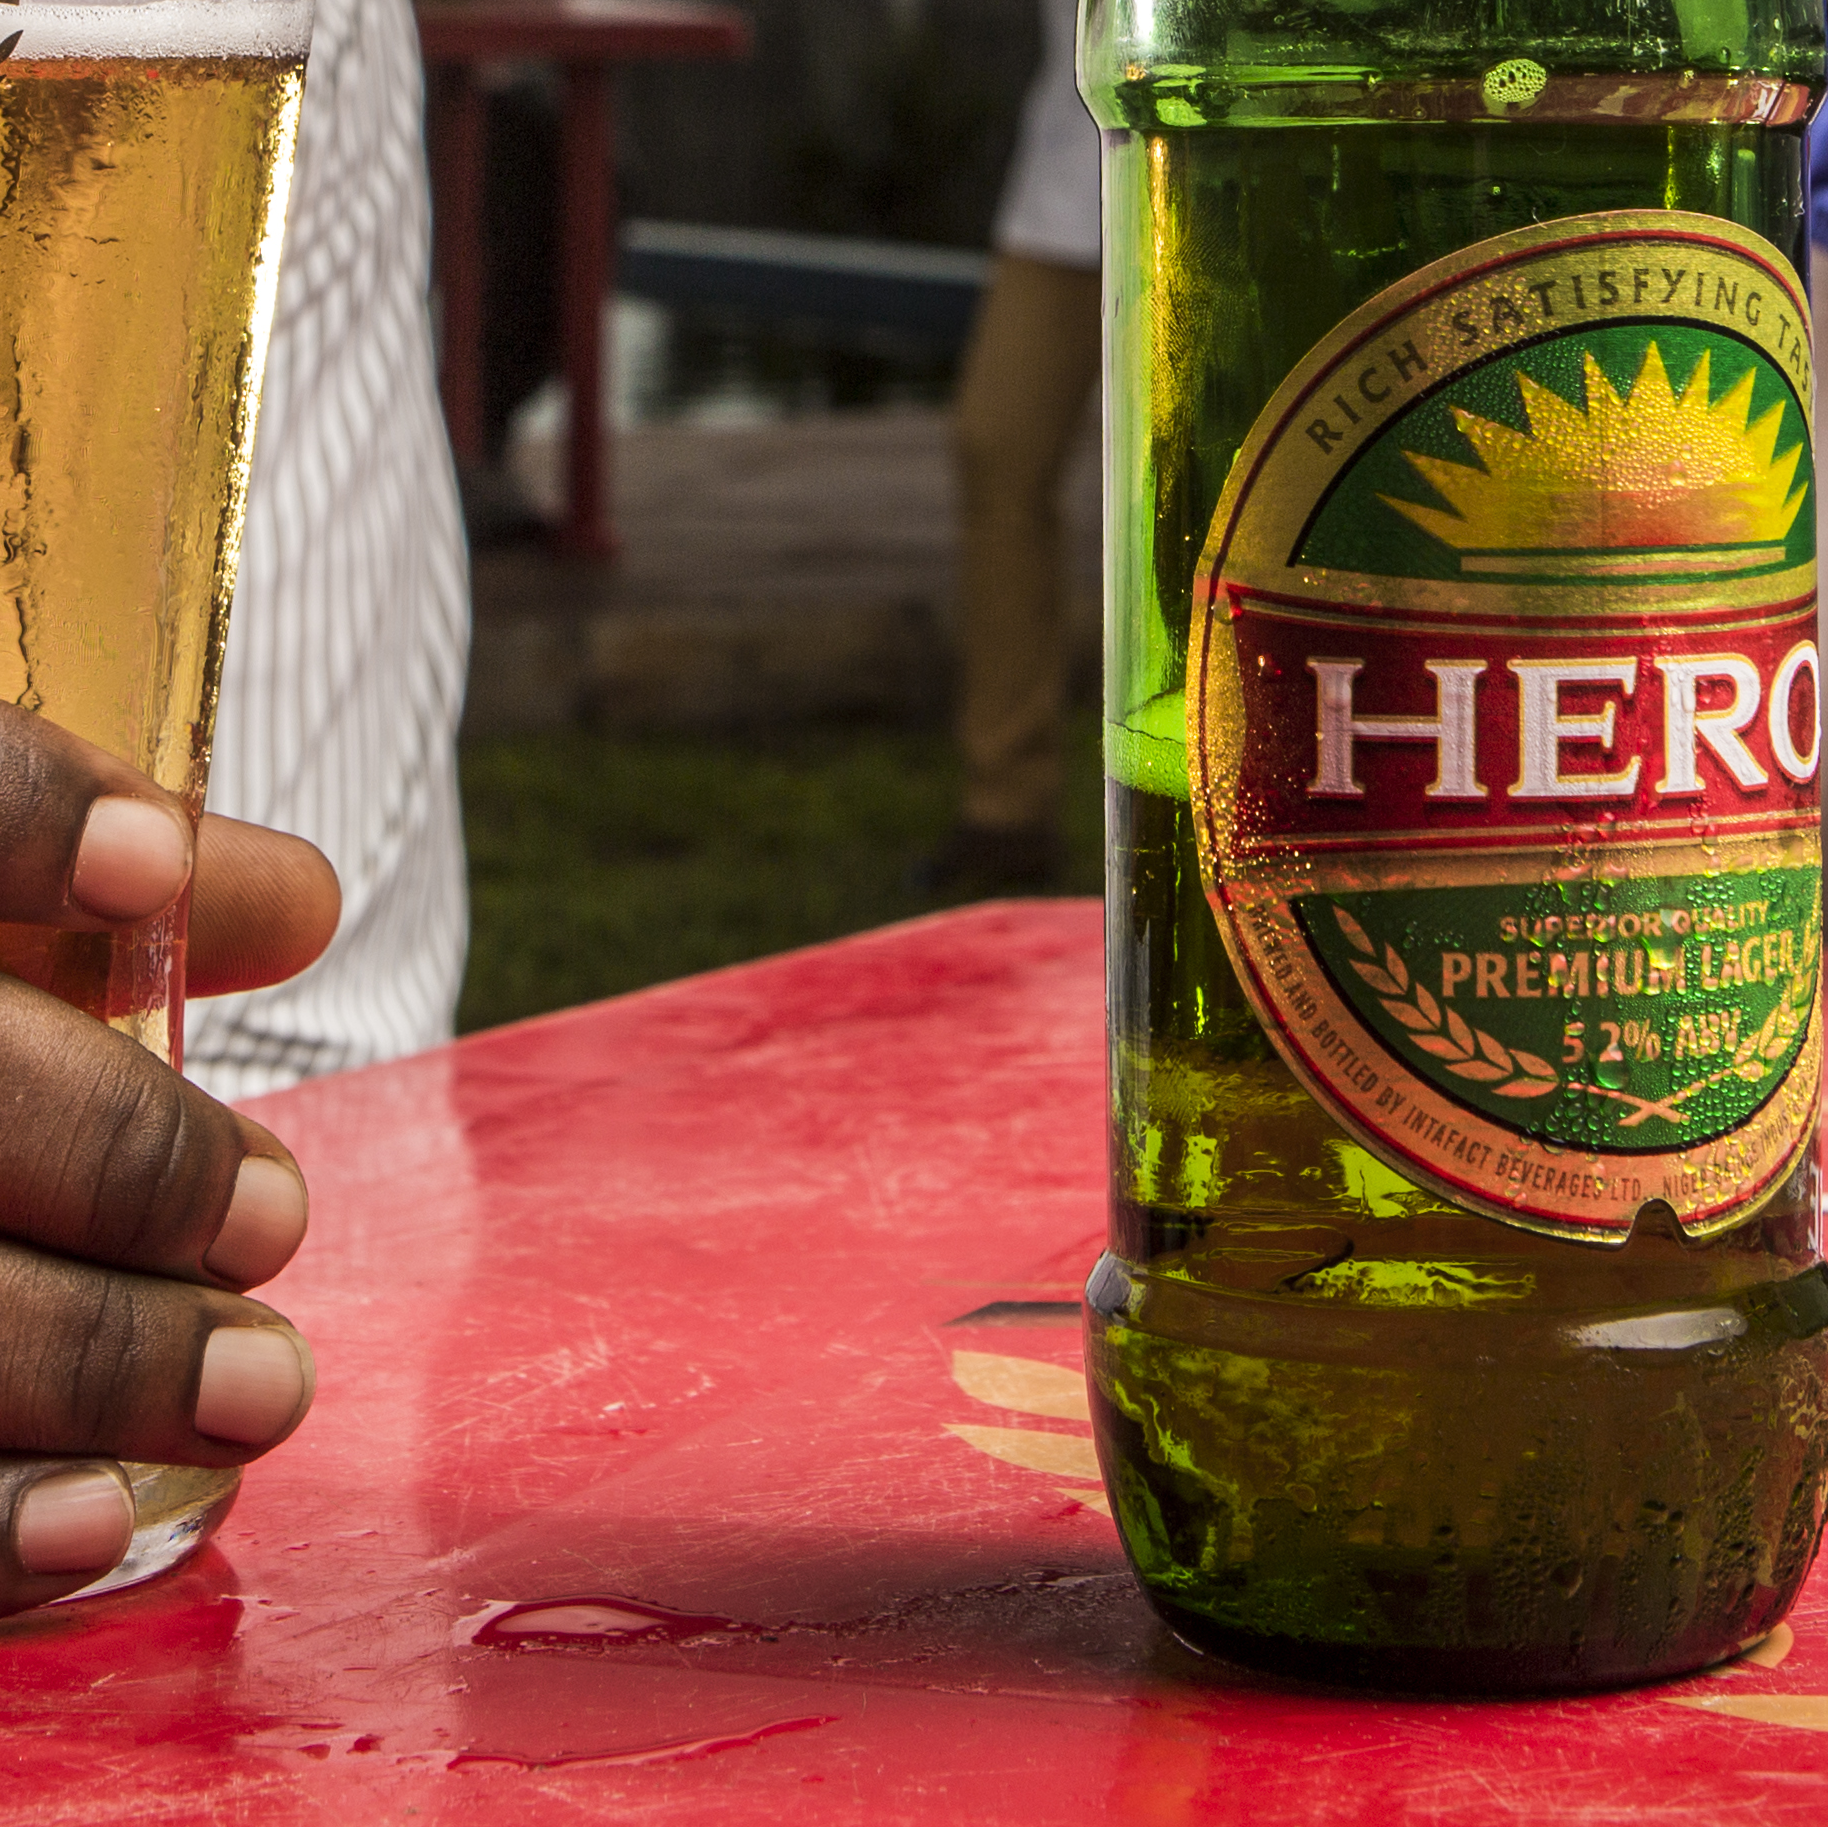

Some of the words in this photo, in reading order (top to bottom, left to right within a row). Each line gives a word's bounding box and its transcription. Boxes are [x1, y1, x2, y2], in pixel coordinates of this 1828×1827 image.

[1305, 339, 1428, 455] RICH
[1451, 267, 1762, 347] SATISFYING
[1306, 639, 1822, 799] HERO
[1441, 943, 1686, 999] PREMIUM
[1700, 929, 1795, 992] LAGER
[1499, 909, 1661, 943] SUPERIOR
[1670, 900, 1770, 936] QUALITY
[1284, 981, 1319, 1022] AND
[1311, 1019, 1380, 1093] BOTTLED
[1375, 1085, 1408, 1115] BY
[1402, 1105, 1494, 1171] INTAFACT
[1495, 1153, 1604, 1199] BEVERAGES
[1675, 1009, 1742, 1062] ABV
